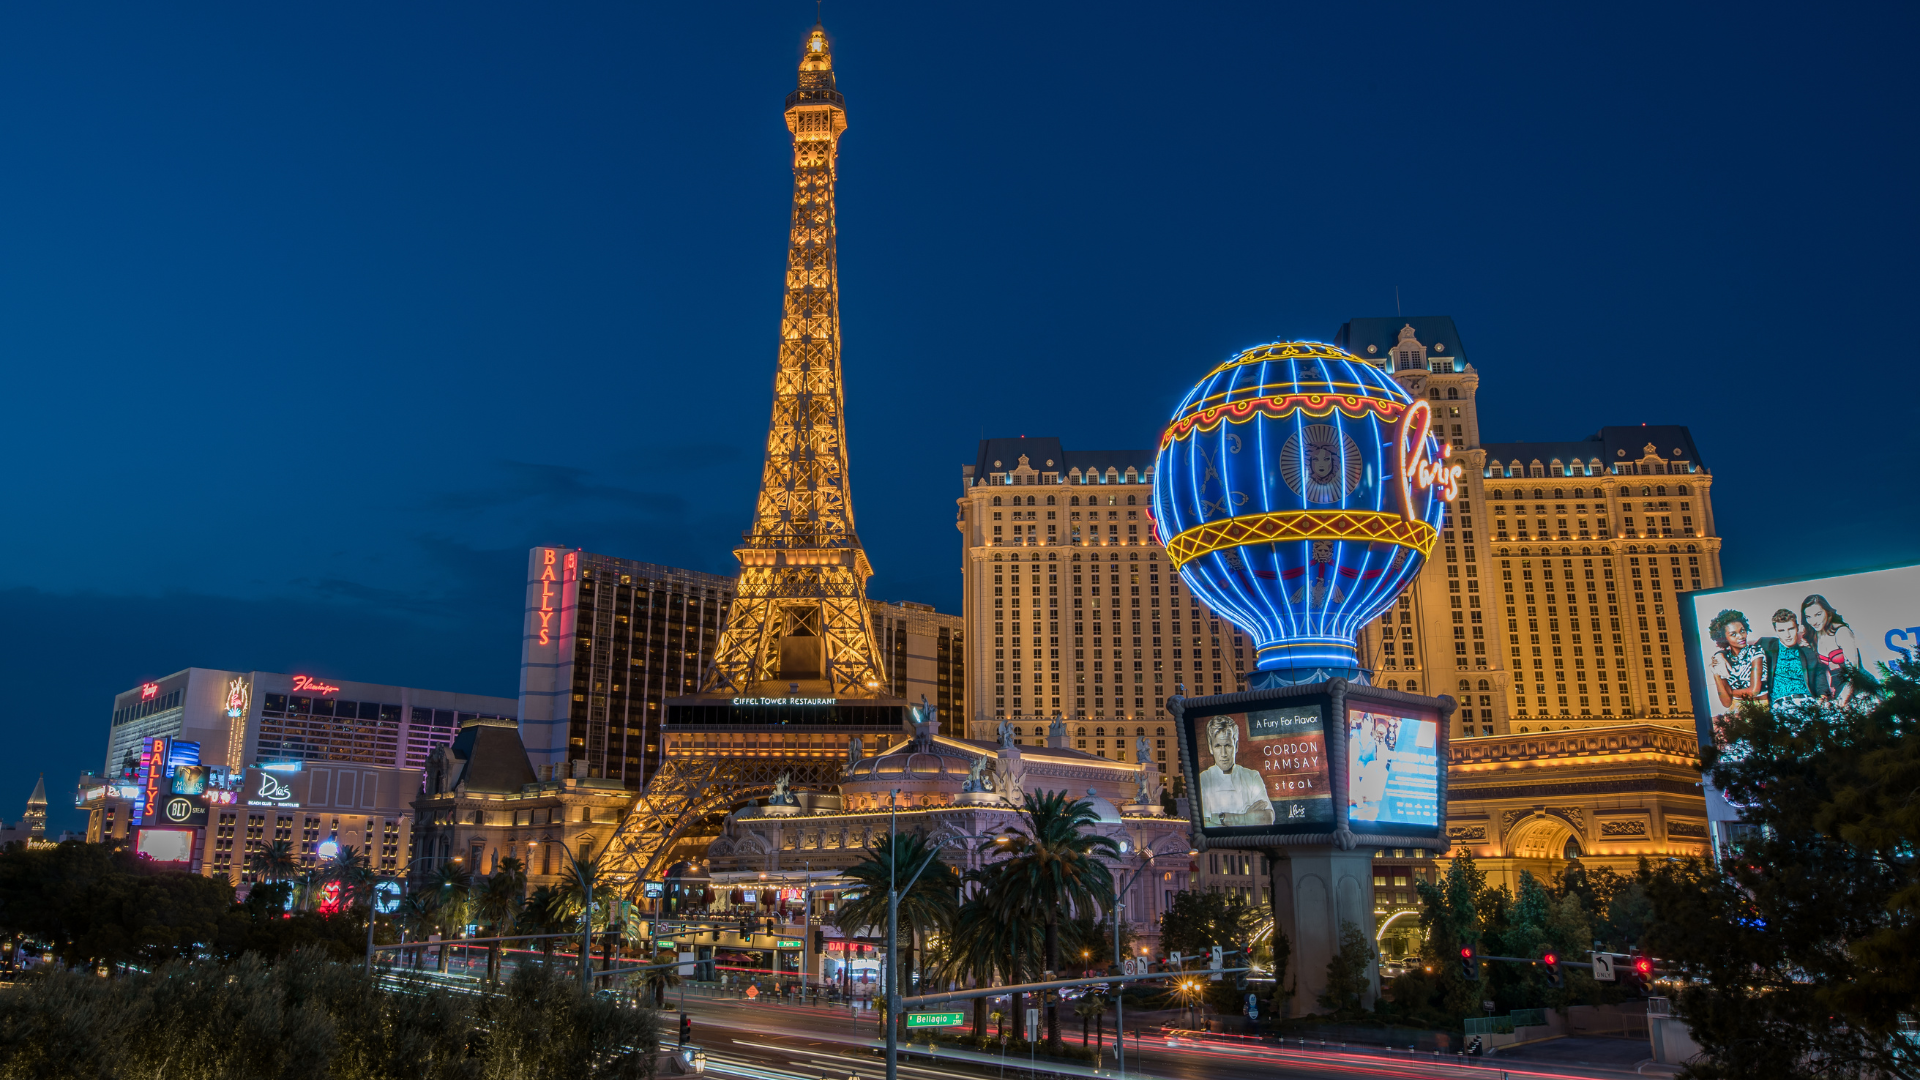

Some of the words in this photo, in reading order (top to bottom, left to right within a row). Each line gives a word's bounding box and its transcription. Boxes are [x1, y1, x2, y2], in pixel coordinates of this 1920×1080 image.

[1400, 399, 1461, 521] Paris
[539, 549, 556, 645] BALLYS
[293, 675, 339, 695] Flamingo
[733, 697, 759, 705] EIFFEL
[760, 697, 787, 705] TOWER
[790, 697, 836, 705] RESTAURANT
[1256, 720, 1262, 728] A
[1263, 719, 1278, 728] Fury
[1280, 717, 1292, 726] For
[1294, 715, 1318, 724] Flavor
[1263, 742, 1318, 756] GORDON
[1265, 756, 1318, 770] RAMSAY
[145, 740, 163, 816] BALLYS
[1275, 779, 1312, 790] steak
[172, 803, 187, 816] BLT
[916, 1014, 947, 1024] Bellagio
